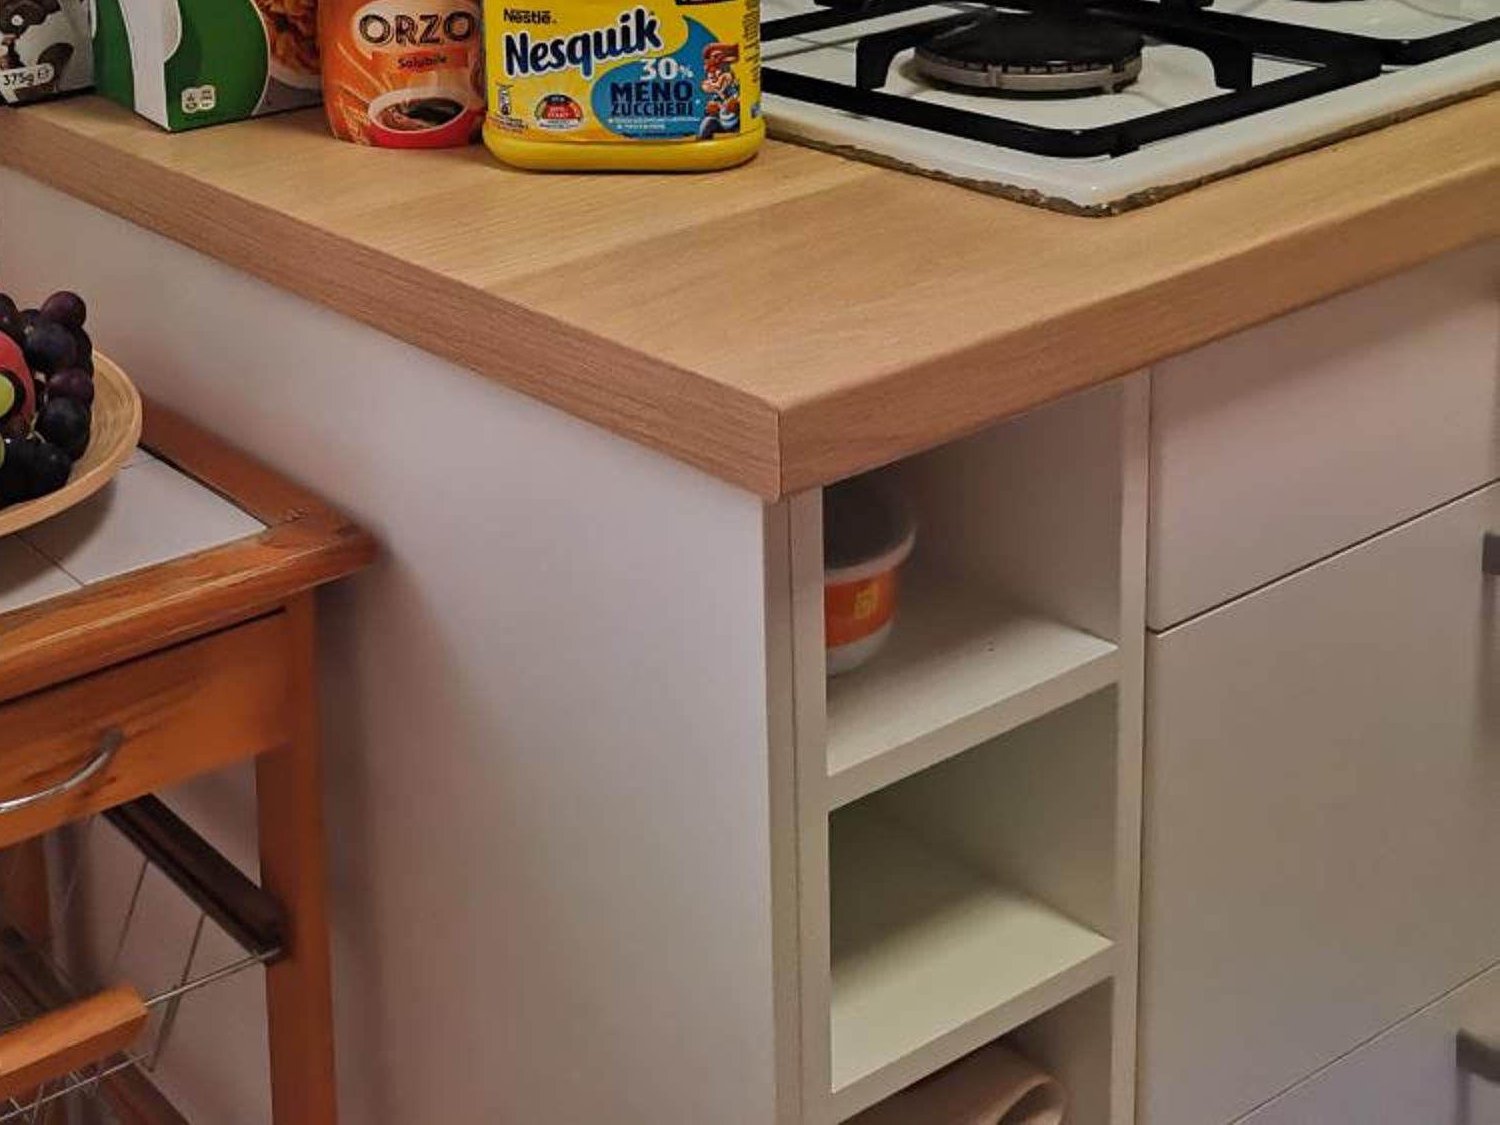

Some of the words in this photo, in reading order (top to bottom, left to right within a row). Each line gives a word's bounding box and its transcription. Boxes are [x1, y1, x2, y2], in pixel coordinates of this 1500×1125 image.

[358, 10, 476, 45] ORZO
[504, 8, 662, 77] Nesquik
[610, 80, 694, 102] MENO
[611, 102, 694, 116] ZUCCHERI
